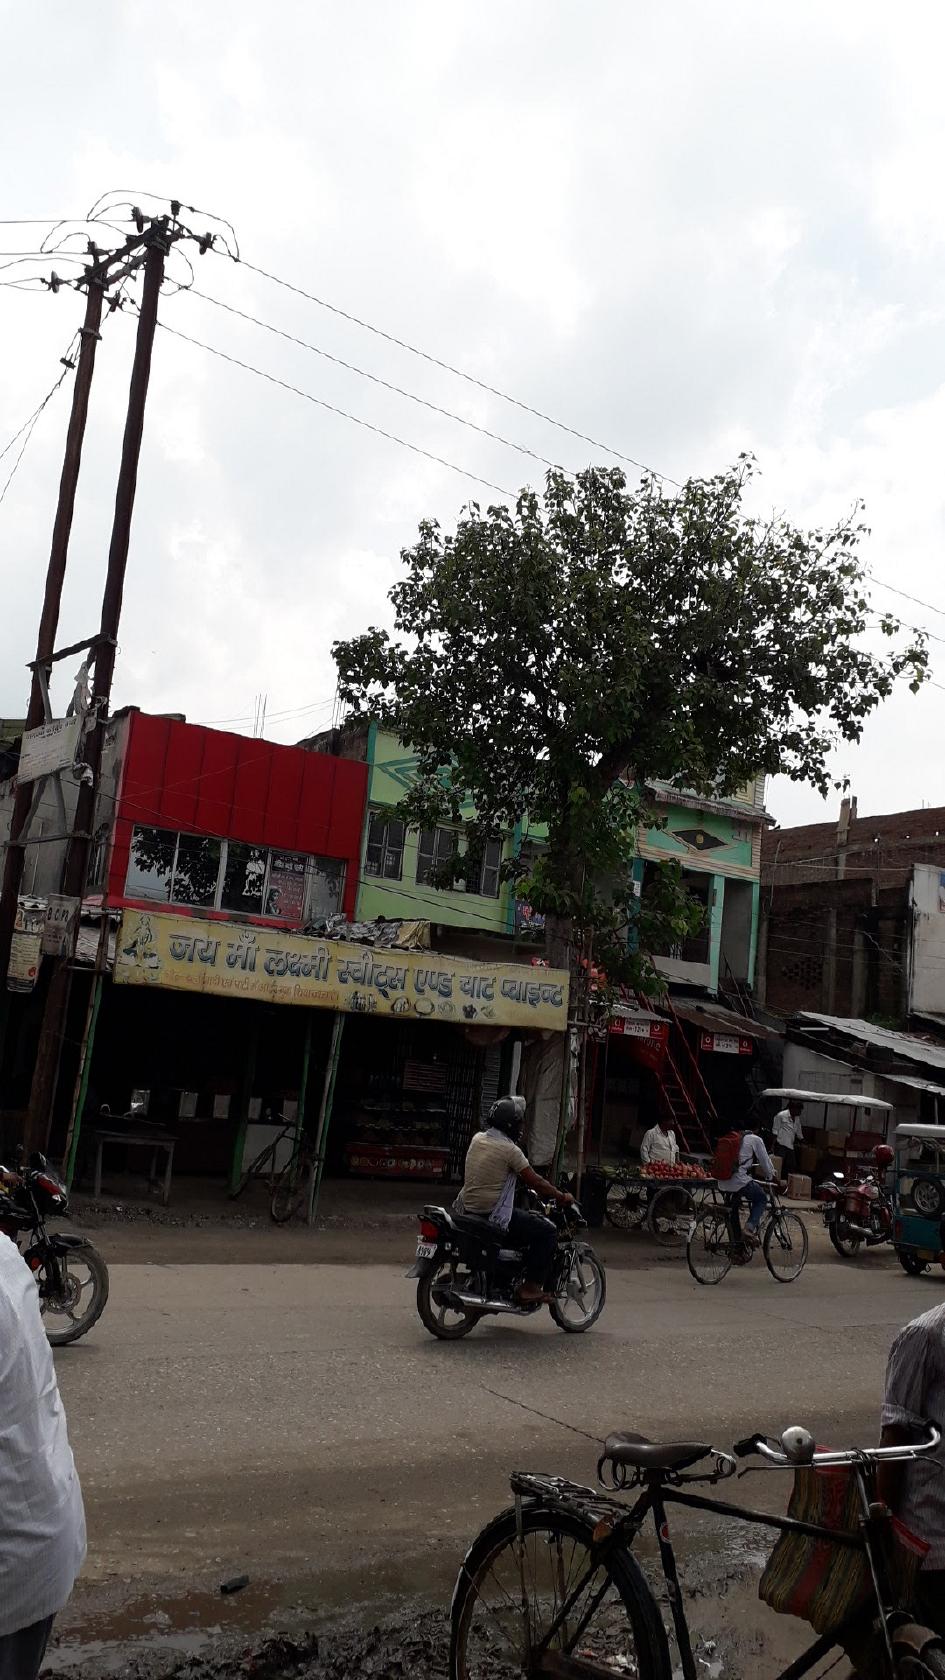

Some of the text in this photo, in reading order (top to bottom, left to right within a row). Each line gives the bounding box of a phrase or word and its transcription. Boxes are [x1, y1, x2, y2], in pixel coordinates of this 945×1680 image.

[168, 934, 221, 967] जय
[263, 946, 333, 982] लक्ष्मी
[337, 951, 410, 999] स्वीट्स
[413, 967, 455, 998] एण्ड
[459, 975, 497, 1001] चाट
